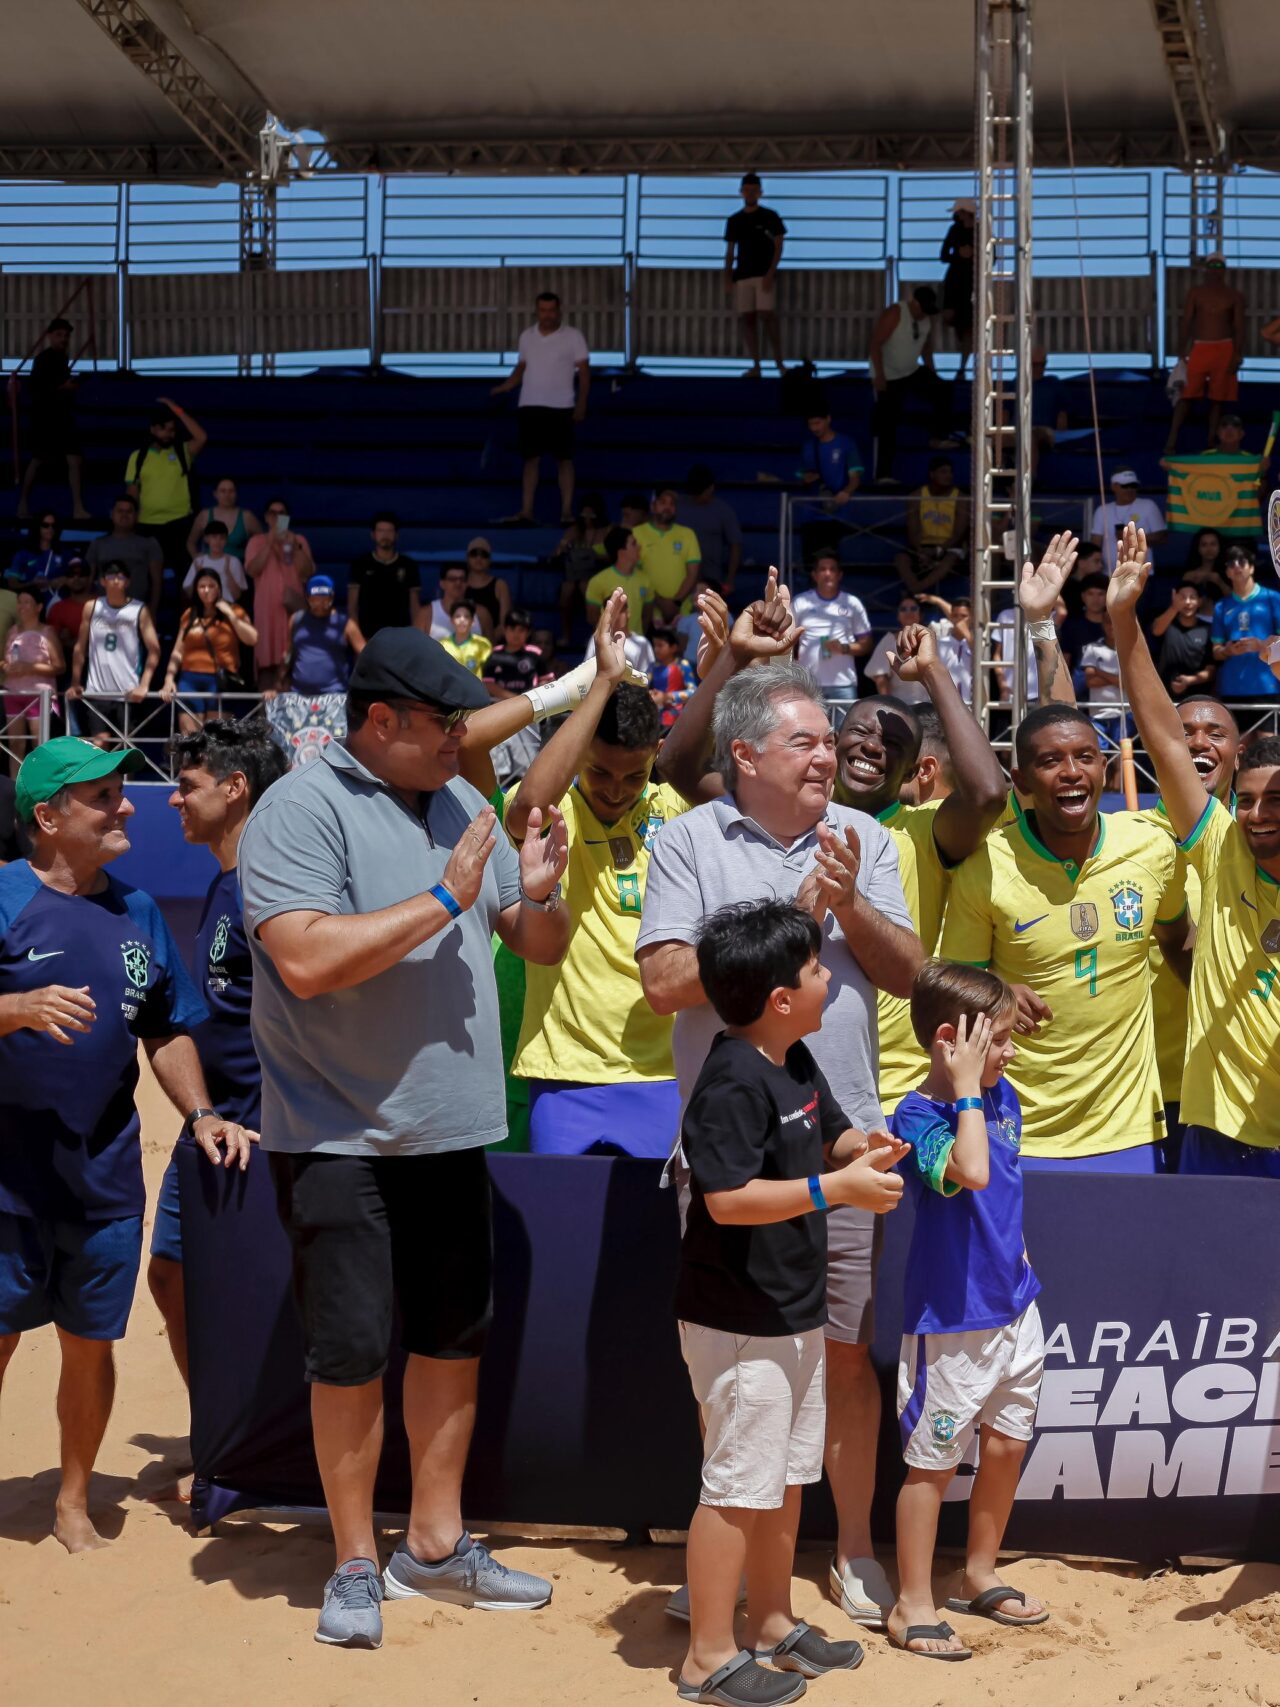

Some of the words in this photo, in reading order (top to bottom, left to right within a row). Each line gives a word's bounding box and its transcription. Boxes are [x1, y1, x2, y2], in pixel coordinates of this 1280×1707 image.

[105, 632, 117, 652] 8
[616, 873, 643, 913] 8
[1115, 931, 1145, 942] BRASIL
[1074, 947, 1098, 997] 9
